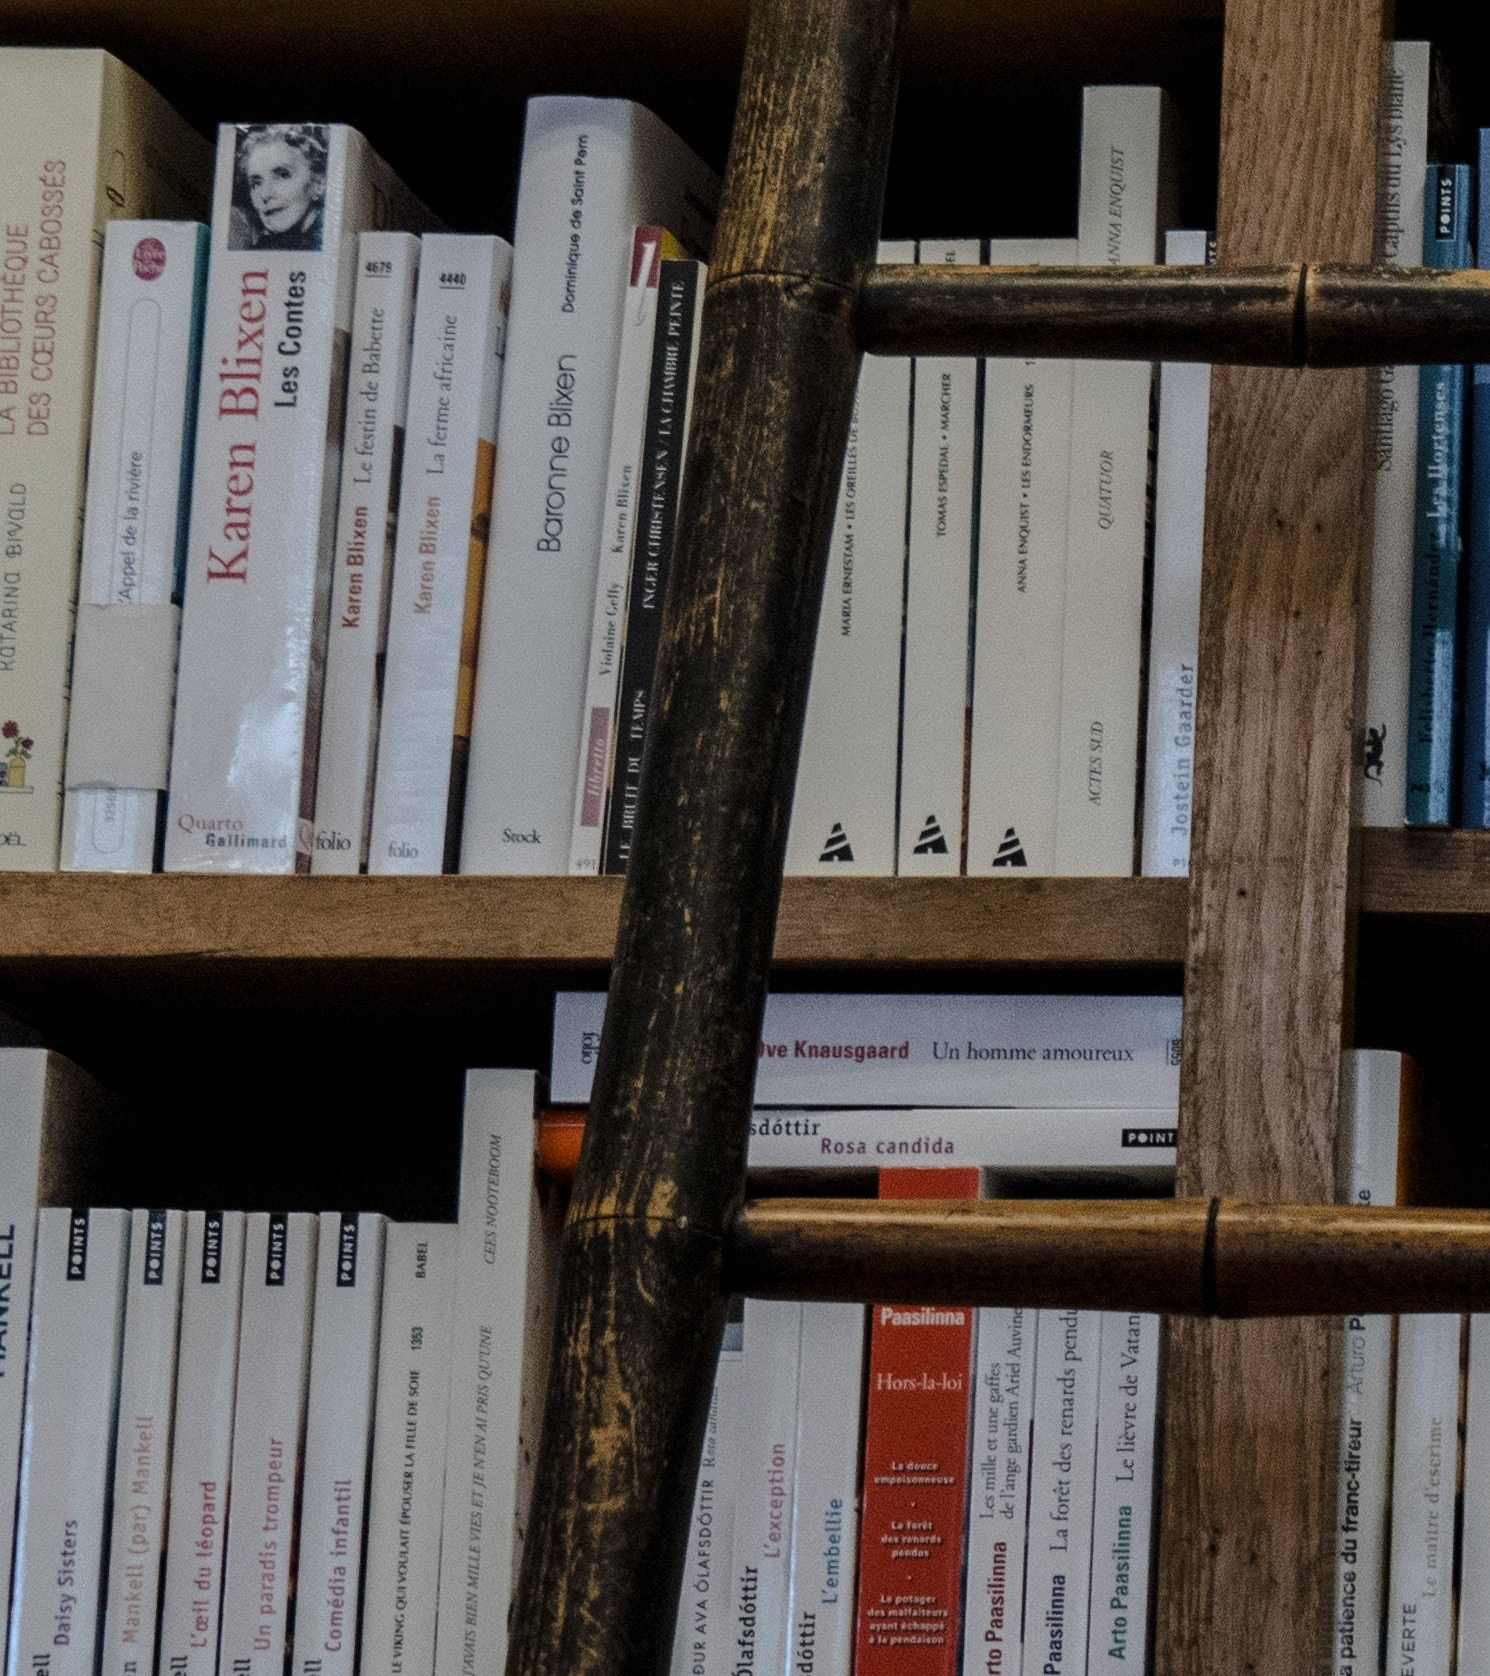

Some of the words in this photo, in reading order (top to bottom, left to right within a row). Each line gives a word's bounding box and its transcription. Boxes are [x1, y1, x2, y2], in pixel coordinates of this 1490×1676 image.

[568, 209, 583, 231] de
[569, 169, 585, 207] Saint
[560, 233, 581, 314] Dominique
[217, 270, 269, 419] Blixen
[276, 271, 306, 357] Contes
[272, 366, 300, 409] Les
[545, 354, 577, 429] Blixen
[1020, 384, 1034, 469] ENDORMEURS
[205, 443, 256, 582] Karen
[535, 435, 571, 554] Baronne
[1019, 470, 1031, 490] LES
[1017, 502, 1031, 556] ENQUIST
[1016, 558, 1027, 594] ANNA
[931, 1040, 960, 1061] Un
[966, 1038, 1037, 1062] homme
[1041, 1045, 1134, 1064] amoureux
[260, 1437, 286, 1534] trompeur
[328, 1479, 352, 1558] infantil
[761, 1443, 787, 1560] L'exception
[256, 1541, 278, 1616] paradis
[323, 1566, 346, 1653] Comédia
[252, 1624, 272, 1652] Un
